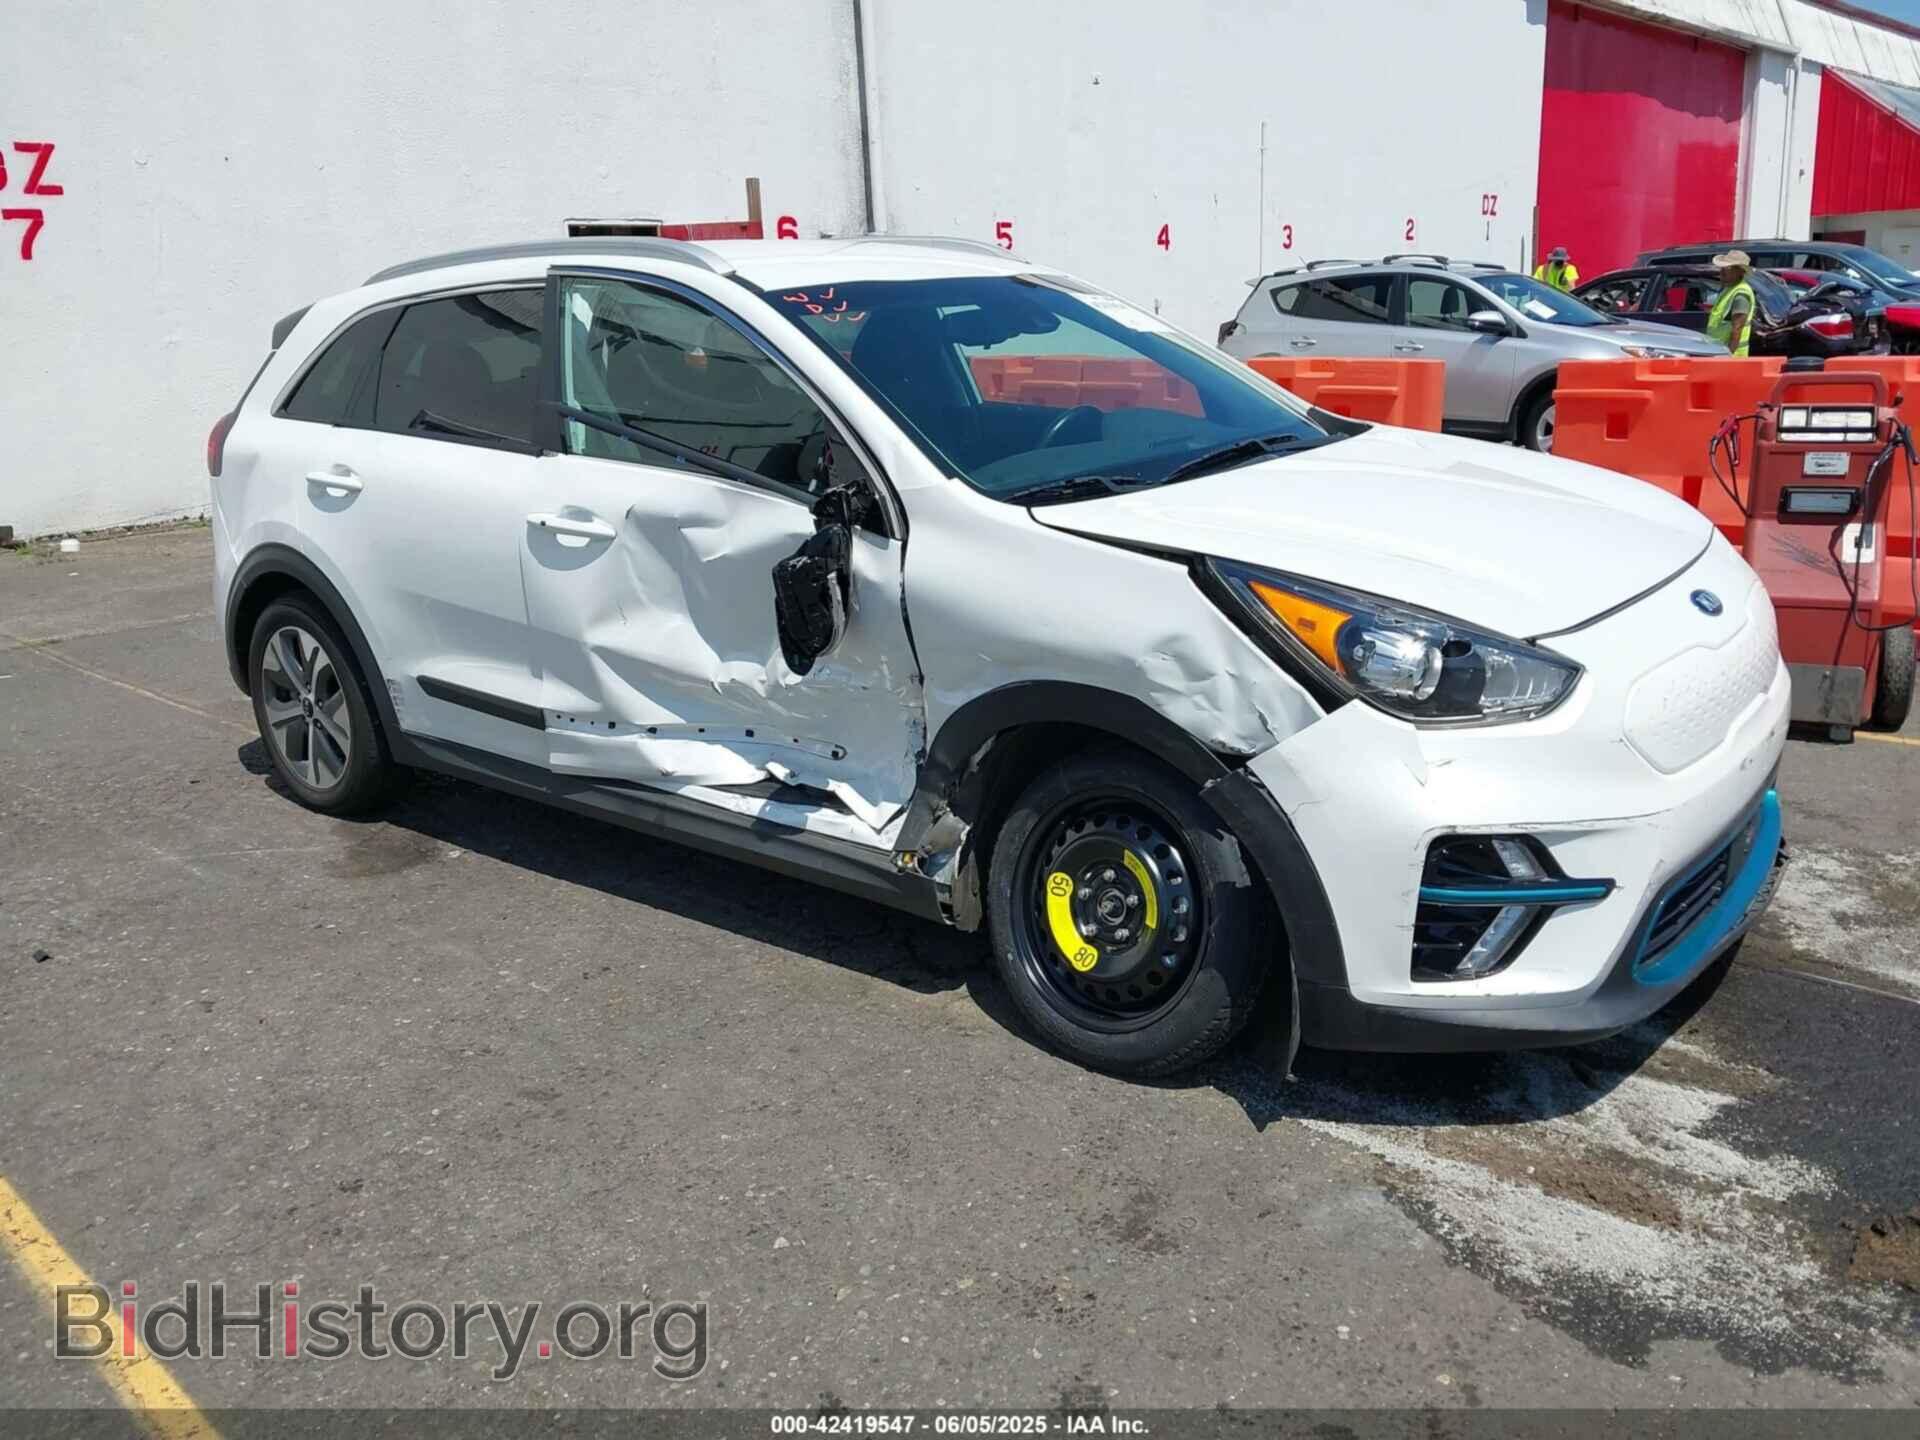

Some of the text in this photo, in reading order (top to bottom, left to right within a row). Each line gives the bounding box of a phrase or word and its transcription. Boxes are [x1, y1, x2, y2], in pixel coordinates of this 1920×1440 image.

[0, 141, 63, 195] Z
[1, 208, 44, 260] 7
[777, 215, 798, 240] 6
[996, 221, 1012, 250] 5
[1157, 223, 1170, 251] 4
[1282, 225, 1292, 249] 3
[1405, 218, 1414, 240] 2
[1050, 875, 1070, 897] 50
[1073, 946, 1096, 968] 80
